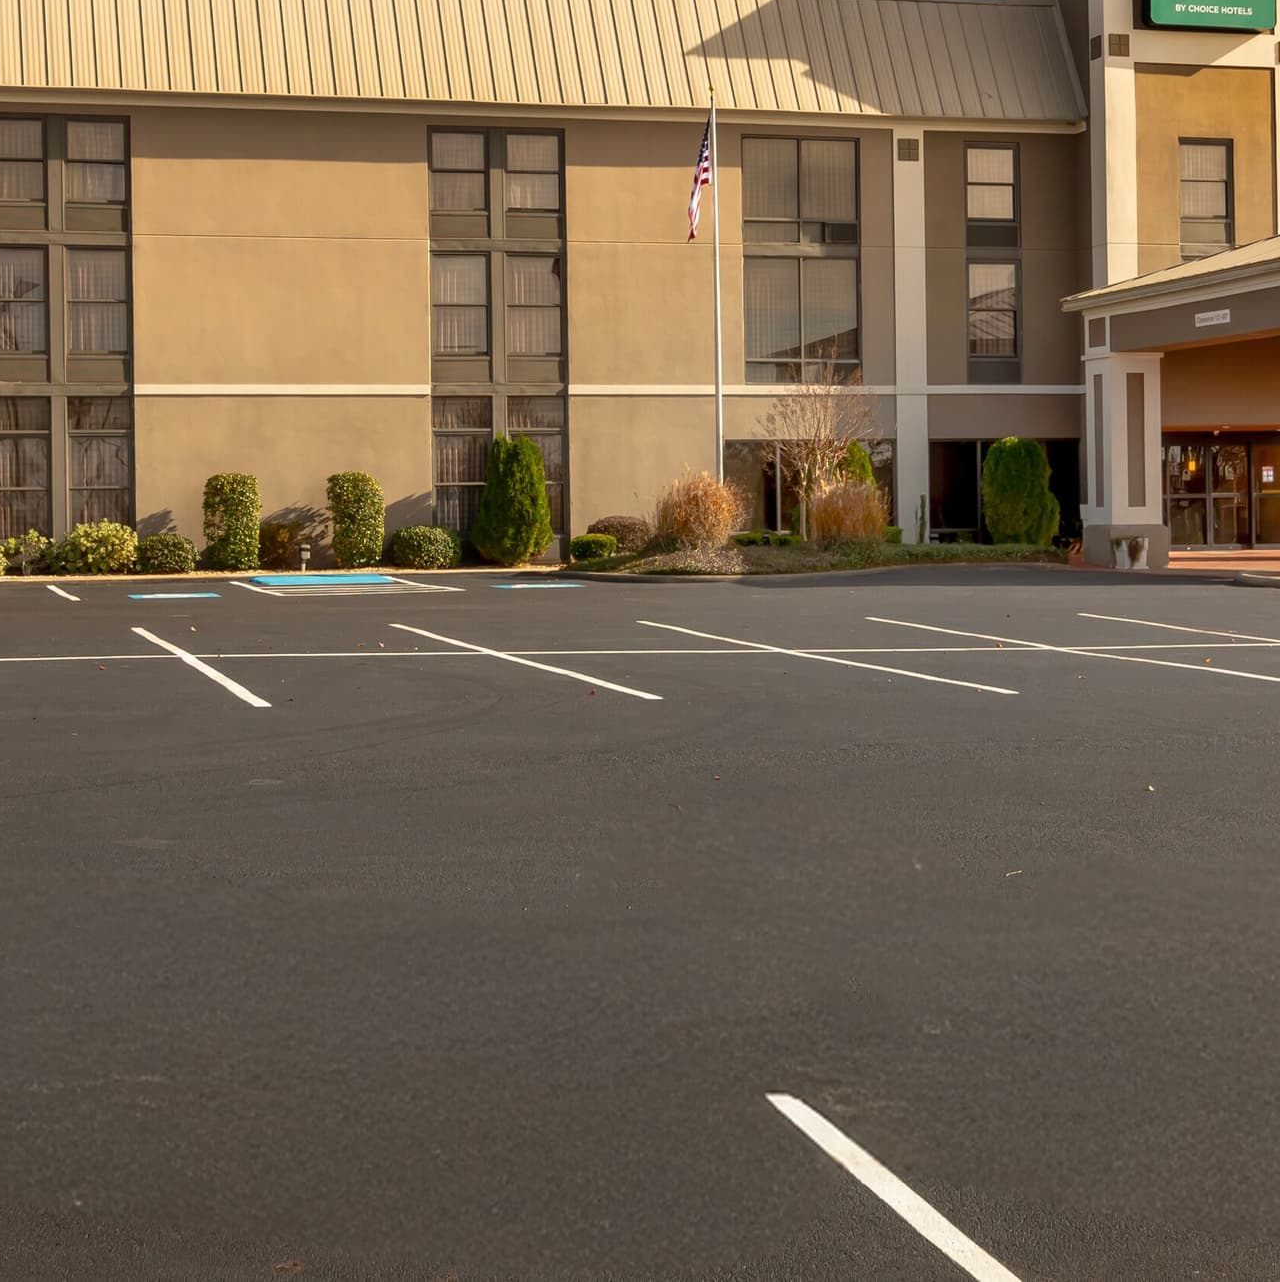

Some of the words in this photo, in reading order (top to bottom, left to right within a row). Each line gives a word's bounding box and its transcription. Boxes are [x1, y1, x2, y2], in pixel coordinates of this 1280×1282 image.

[1175, 4, 1186, 13] BY
[1188, 5, 1220, 15] CHOICE
[1221, 7, 1253, 16] HOTELS
